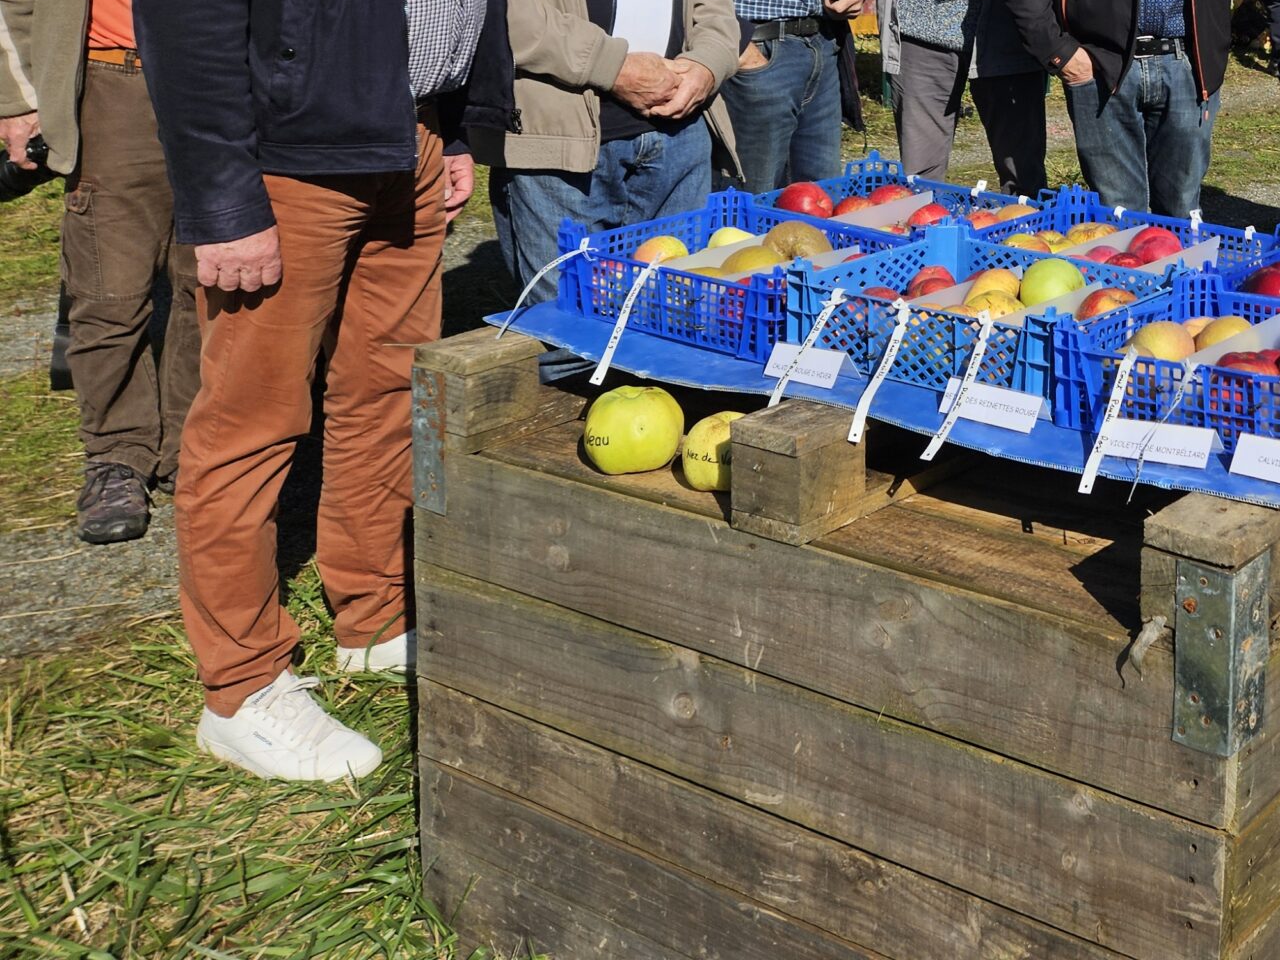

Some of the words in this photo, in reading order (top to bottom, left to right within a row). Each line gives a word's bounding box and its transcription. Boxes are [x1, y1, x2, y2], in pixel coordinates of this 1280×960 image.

[965, 397, 978, 405] DES
[979, 400, 1014, 413] REINETTES
[1015, 407, 1037, 418] ROUGE
[686, 448, 699, 461] Nez
[701, 450, 719, 463] de
[721, 454, 731, 466] Ve
[1110, 439, 1144, 450] VIOLETTE
[1156, 446, 1206, 459] MONTBÉLIARD
